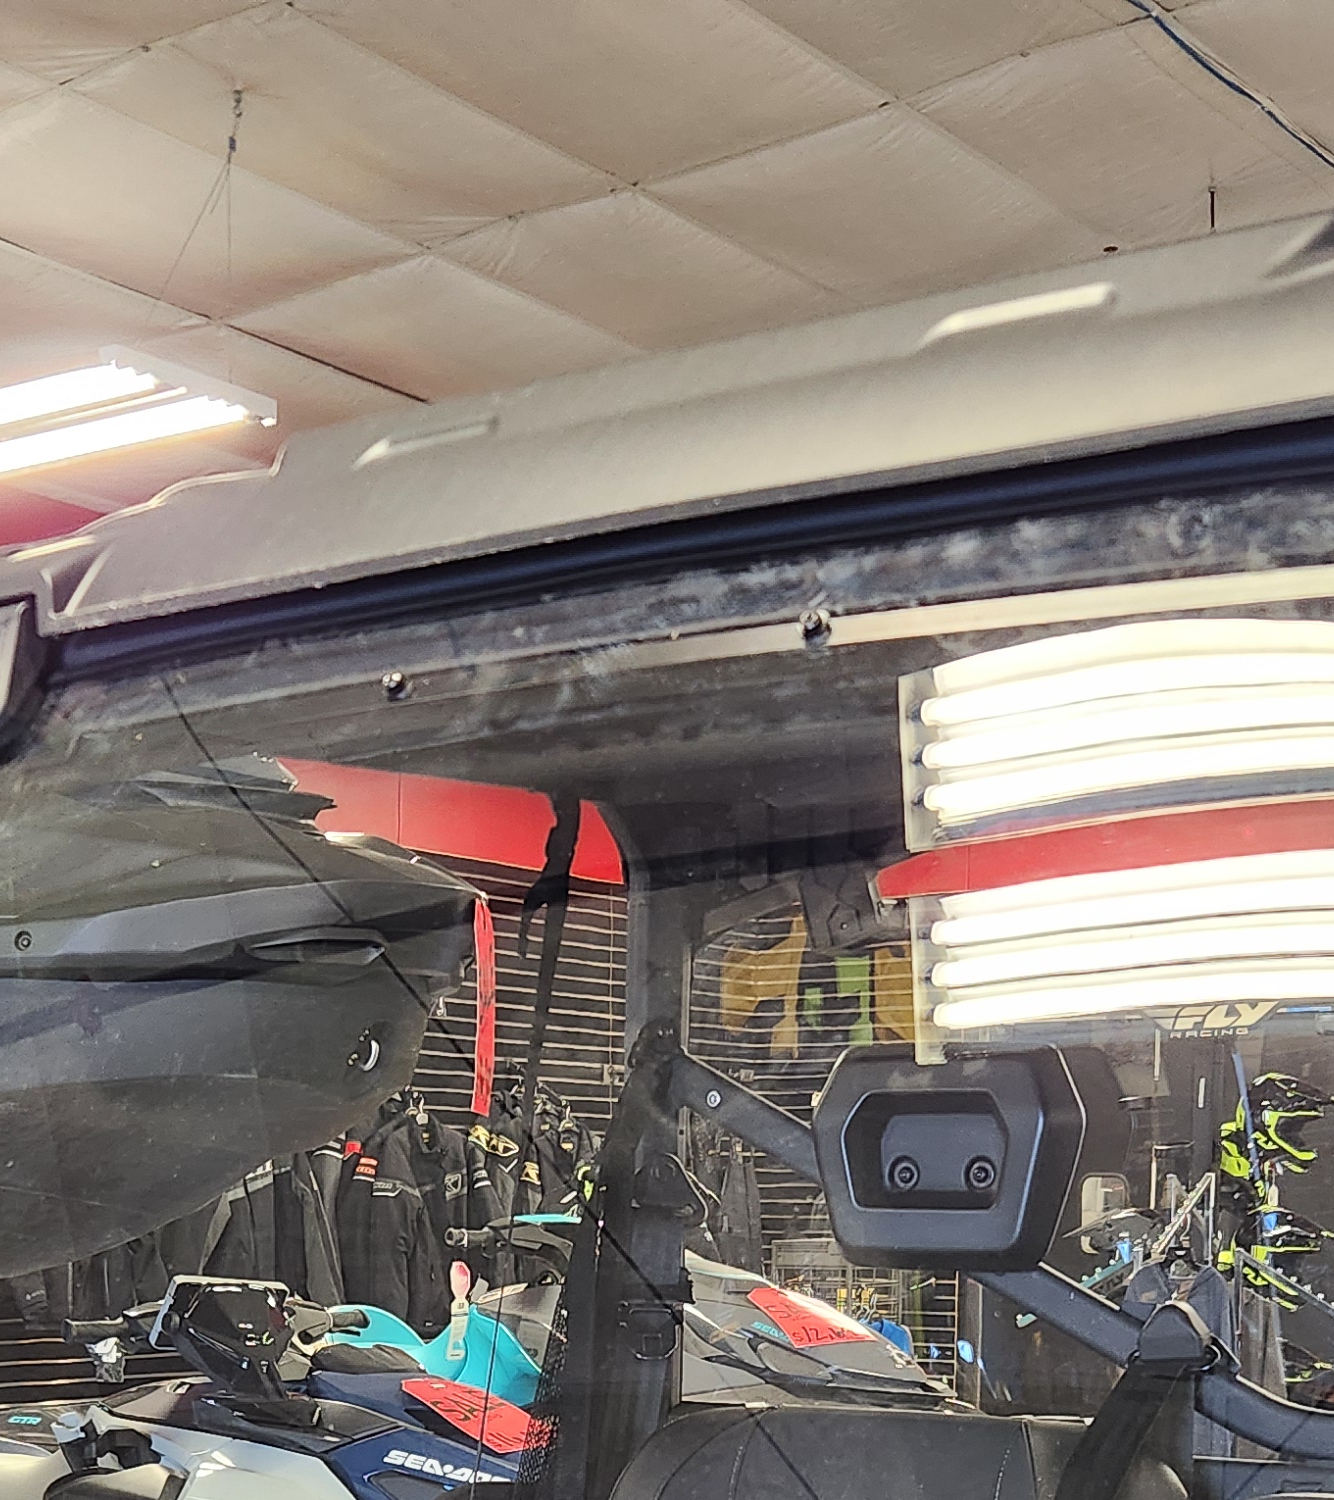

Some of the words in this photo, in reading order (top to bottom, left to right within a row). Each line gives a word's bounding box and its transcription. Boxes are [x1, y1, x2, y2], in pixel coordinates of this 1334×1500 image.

[1155, 1001, 1280, 1030] FLY
[1169, 1027, 1249, 1039] RACING
[7, 1415, 43, 1426] GTR
